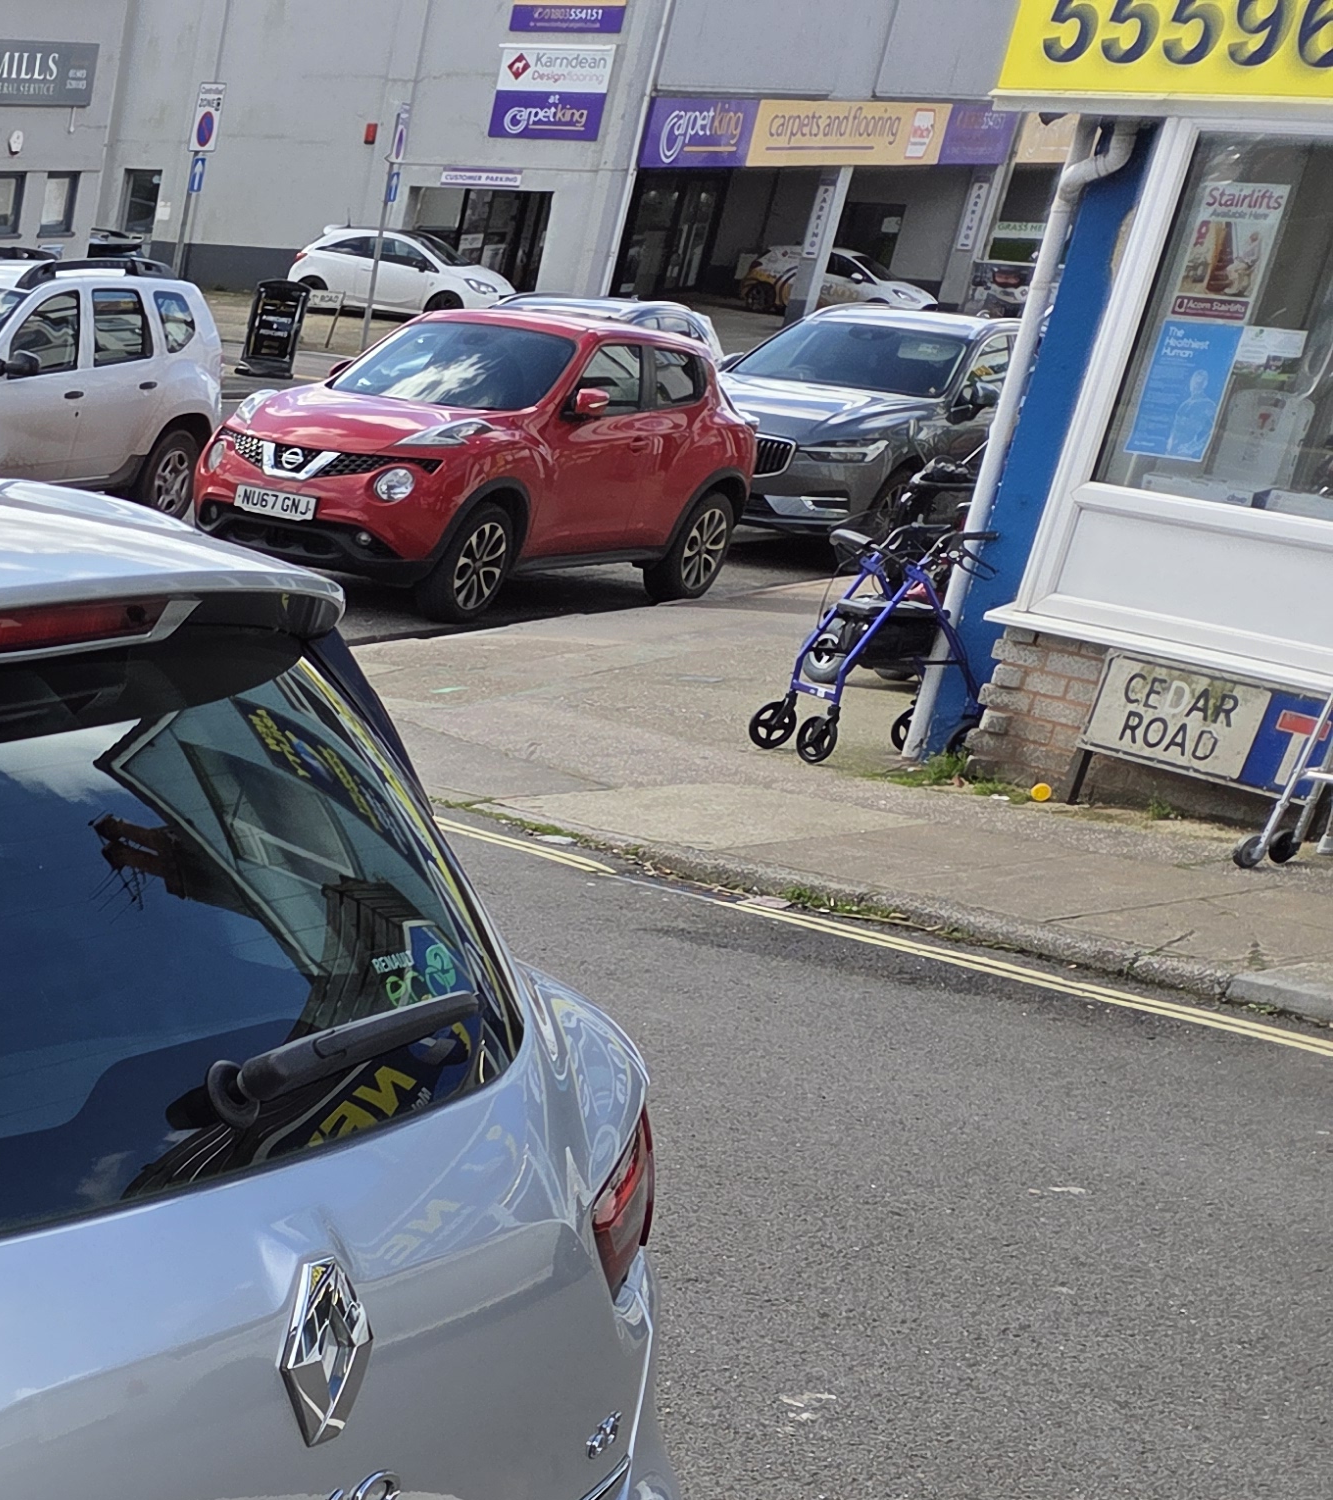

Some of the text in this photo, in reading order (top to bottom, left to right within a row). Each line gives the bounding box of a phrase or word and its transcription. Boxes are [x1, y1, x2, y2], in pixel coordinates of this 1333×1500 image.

[534, 52, 607, 69] Karndean
[19, 83, 55, 96] SERVICE
[548, 95, 560, 103] at
[769, 106, 902, 145] carpets and flooring
[485, 175, 518, 183] PARKING
[1205, 187, 1283, 211] Stairlifts
[809, 187, 830, 248] PARKING
[1210, 209, 1270, 220] Available Here
[998, 222, 1028, 233] GRASS
[1188, 300, 1211, 310] Acorn
[1212, 301, 1245, 313] Stairlifts
[1169, 326, 1185, 338] The
[1164, 337, 1210, 350] Healthiest
[1161, 347, 1193, 358] Human
[242, 488, 310, 516] NU67 GNJ
[1123, 672, 1240, 728] CEDAR
[1119, 711, 1219, 761] ROAD
